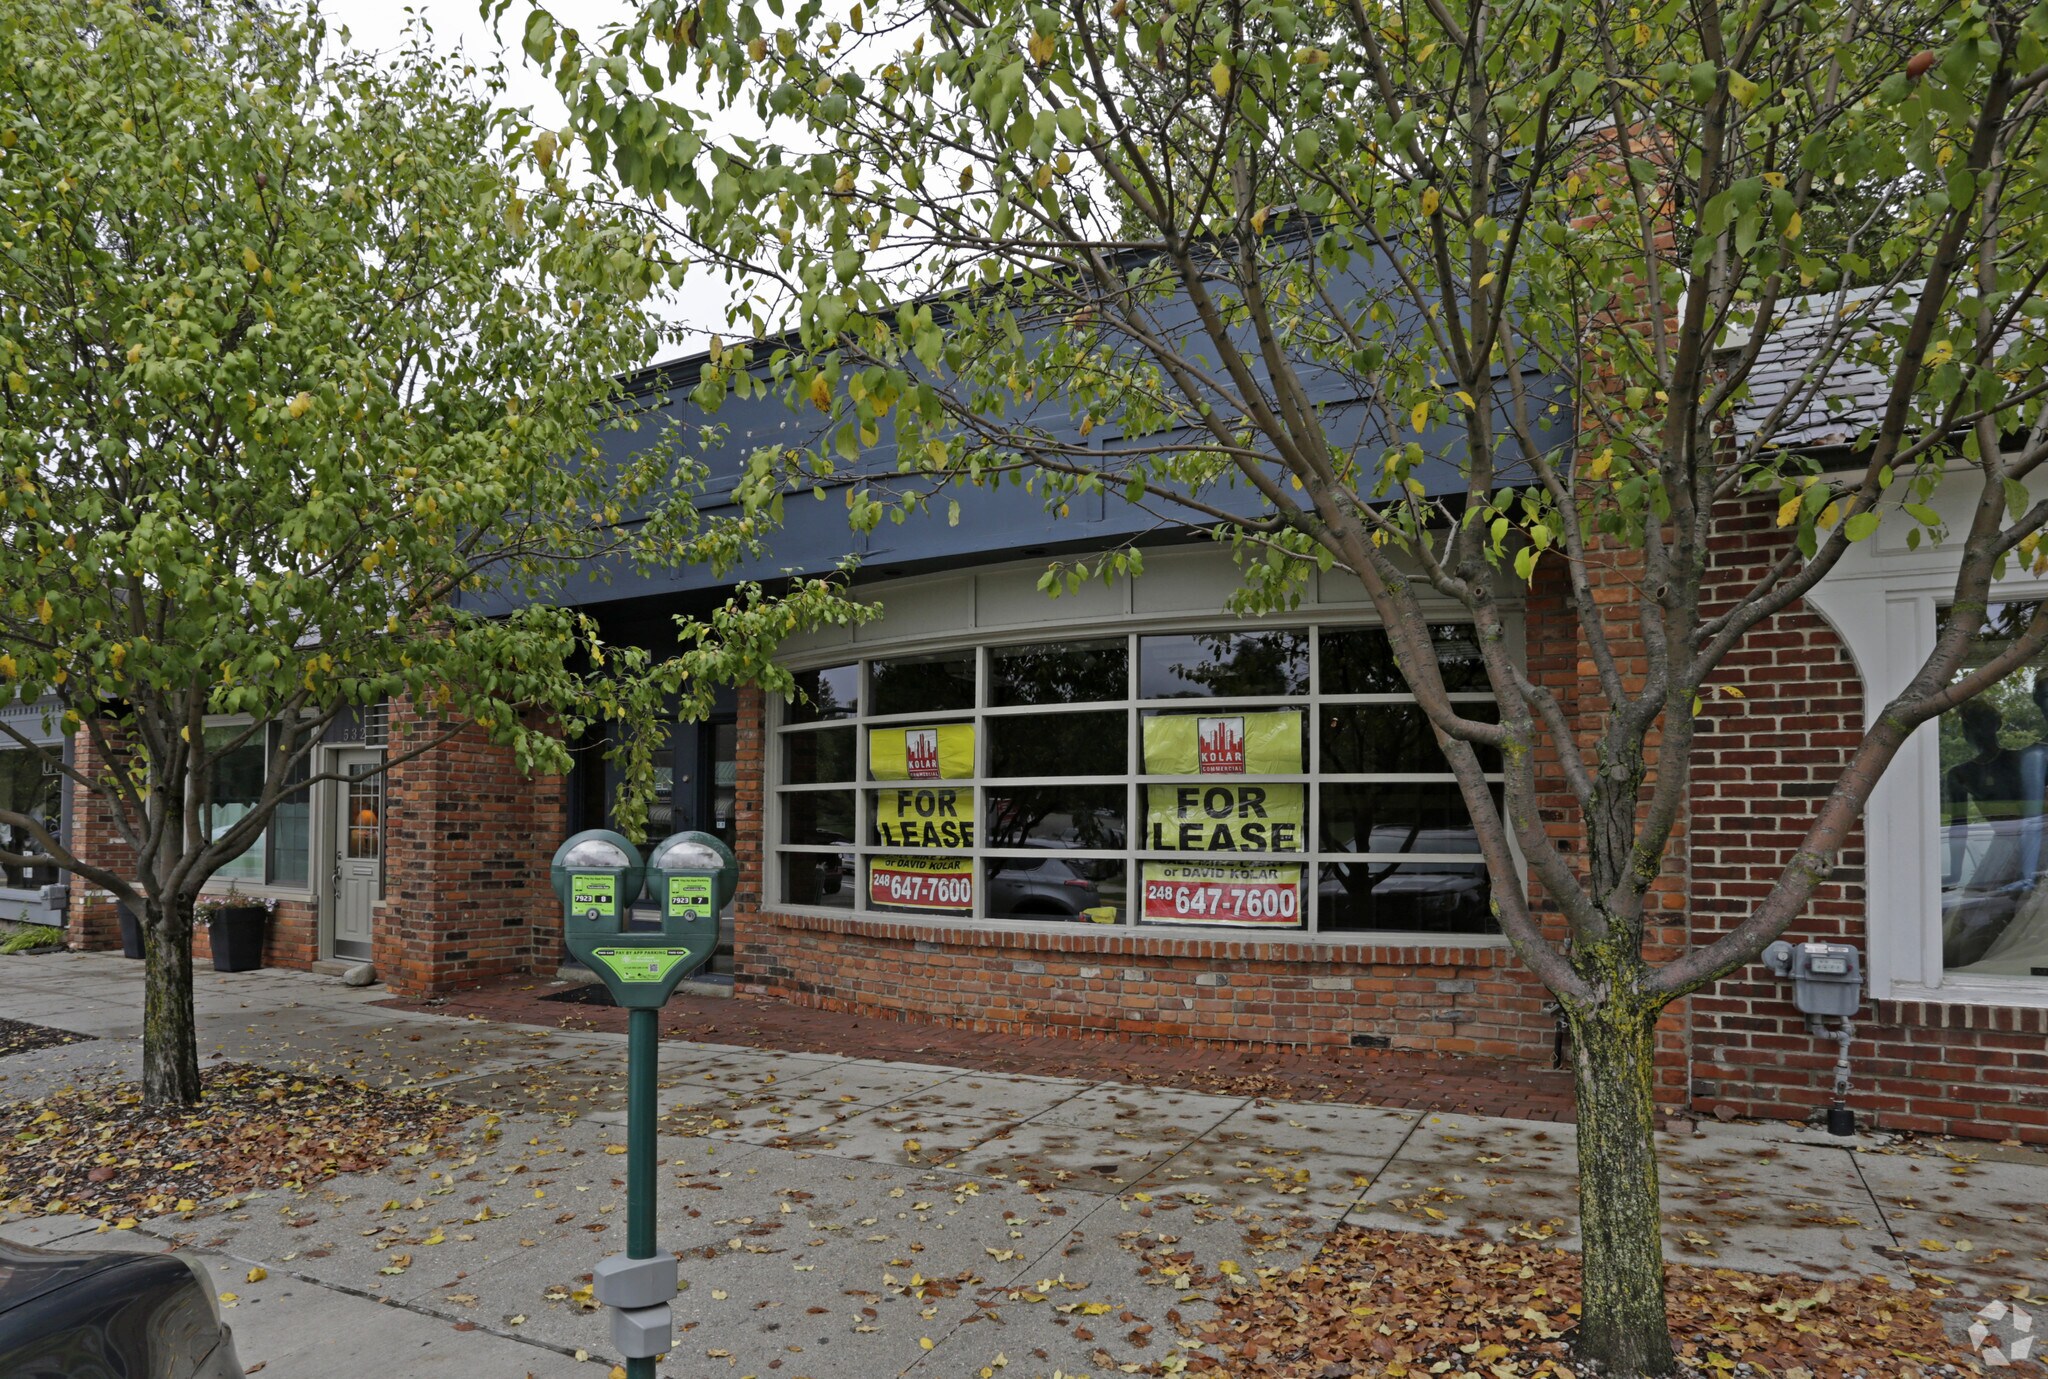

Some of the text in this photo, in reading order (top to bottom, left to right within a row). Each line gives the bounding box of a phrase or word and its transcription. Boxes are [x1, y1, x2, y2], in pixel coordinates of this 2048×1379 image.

[343, 728, 366, 741] 532
[908, 759, 937, 769] KOLAR
[1201, 752, 1242, 762] KOLAR
[897, 789, 957, 818] FOR
[1177, 786, 1268, 819] FOR
[881, 820, 974, 848] LEASE
[1153, 822, 1296, 852] LEASE
[897, 859, 926, 869] DAVID
[928, 860, 961, 870] KOLAR
[1164, 867, 1278, 880] or DAVID KOLAR
[873, 873, 971, 903] 248 647-7600
[1148, 885, 1295, 918] 248 647-7600
